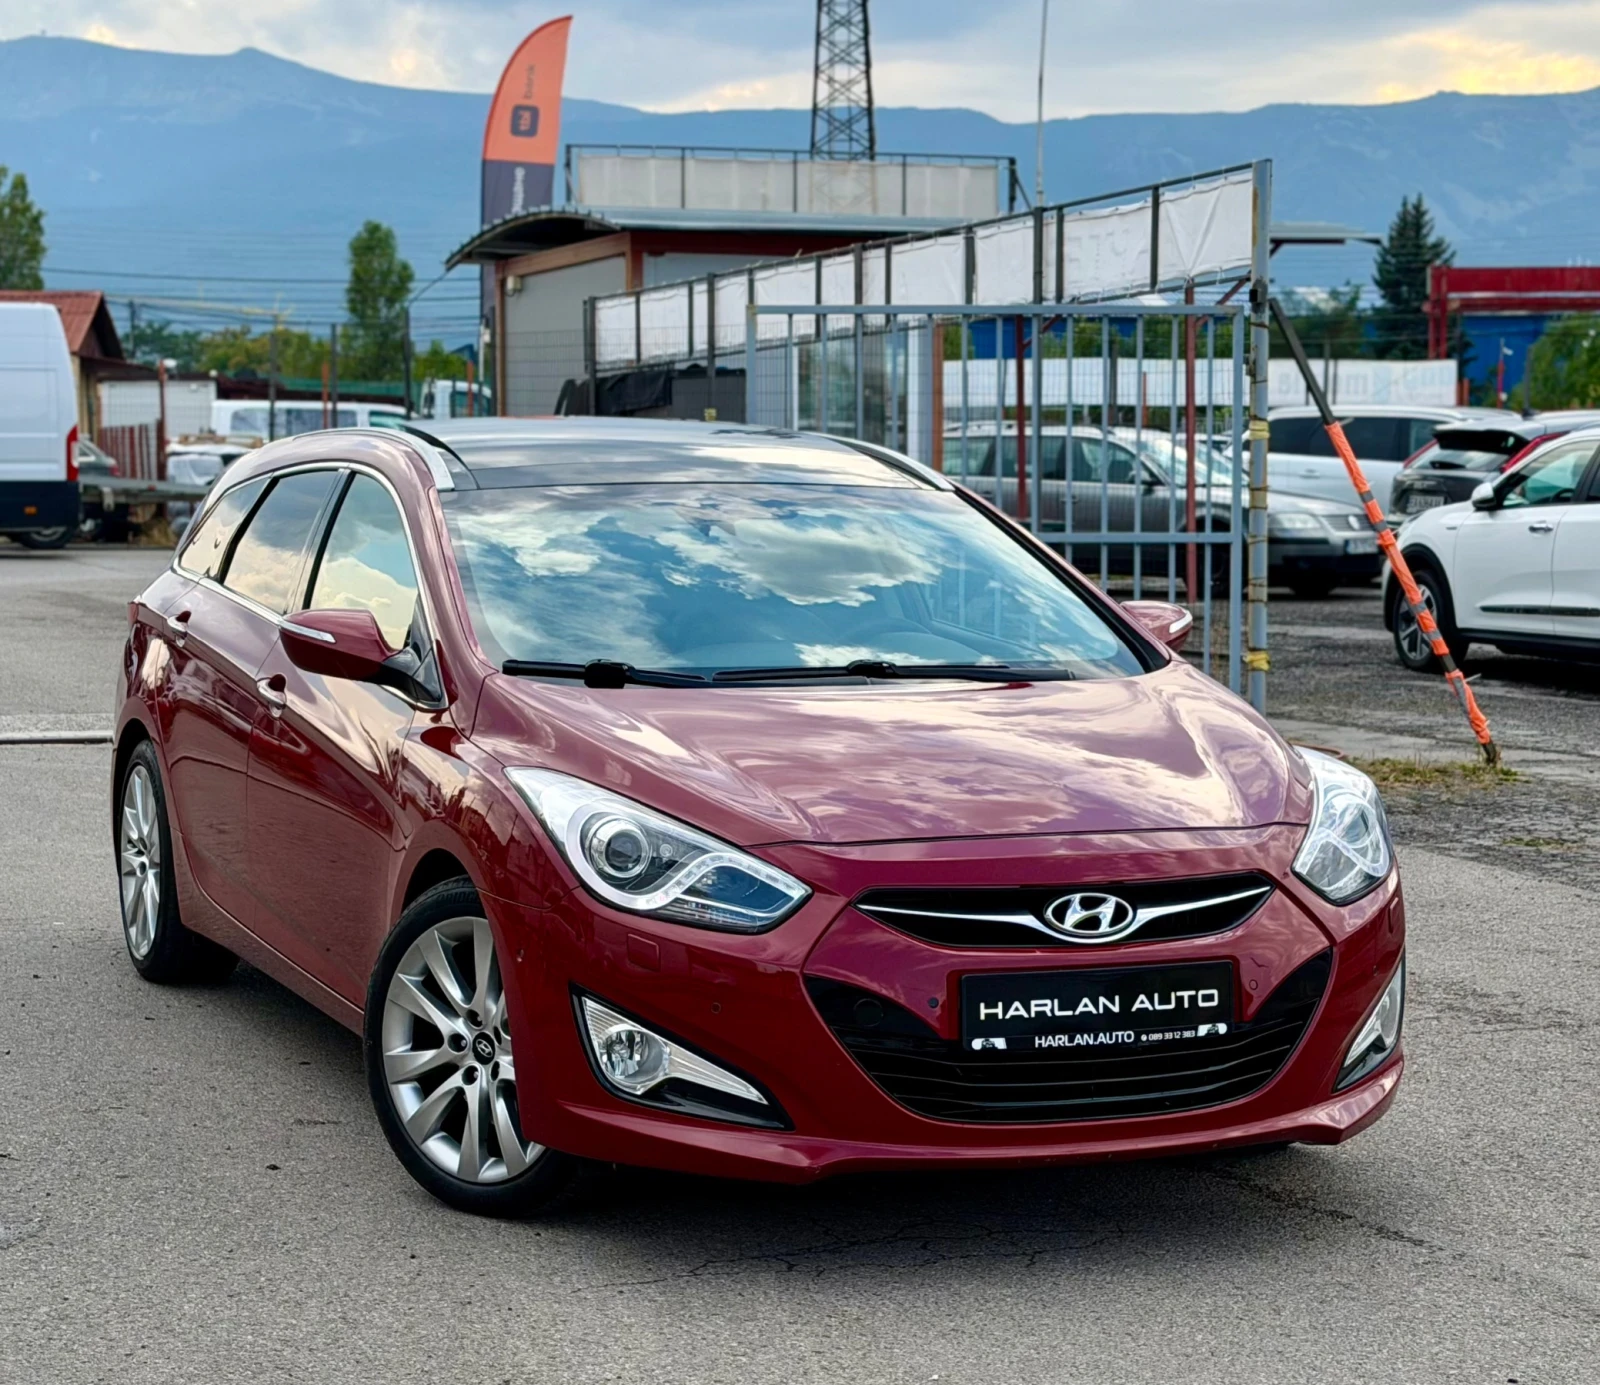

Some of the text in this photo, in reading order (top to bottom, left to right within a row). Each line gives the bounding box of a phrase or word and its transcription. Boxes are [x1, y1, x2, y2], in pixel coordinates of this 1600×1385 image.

[979, 989, 1219, 1020] HARLAN AUTO
[1034, 1030, 1135, 1048] HARLAN.AUTO
